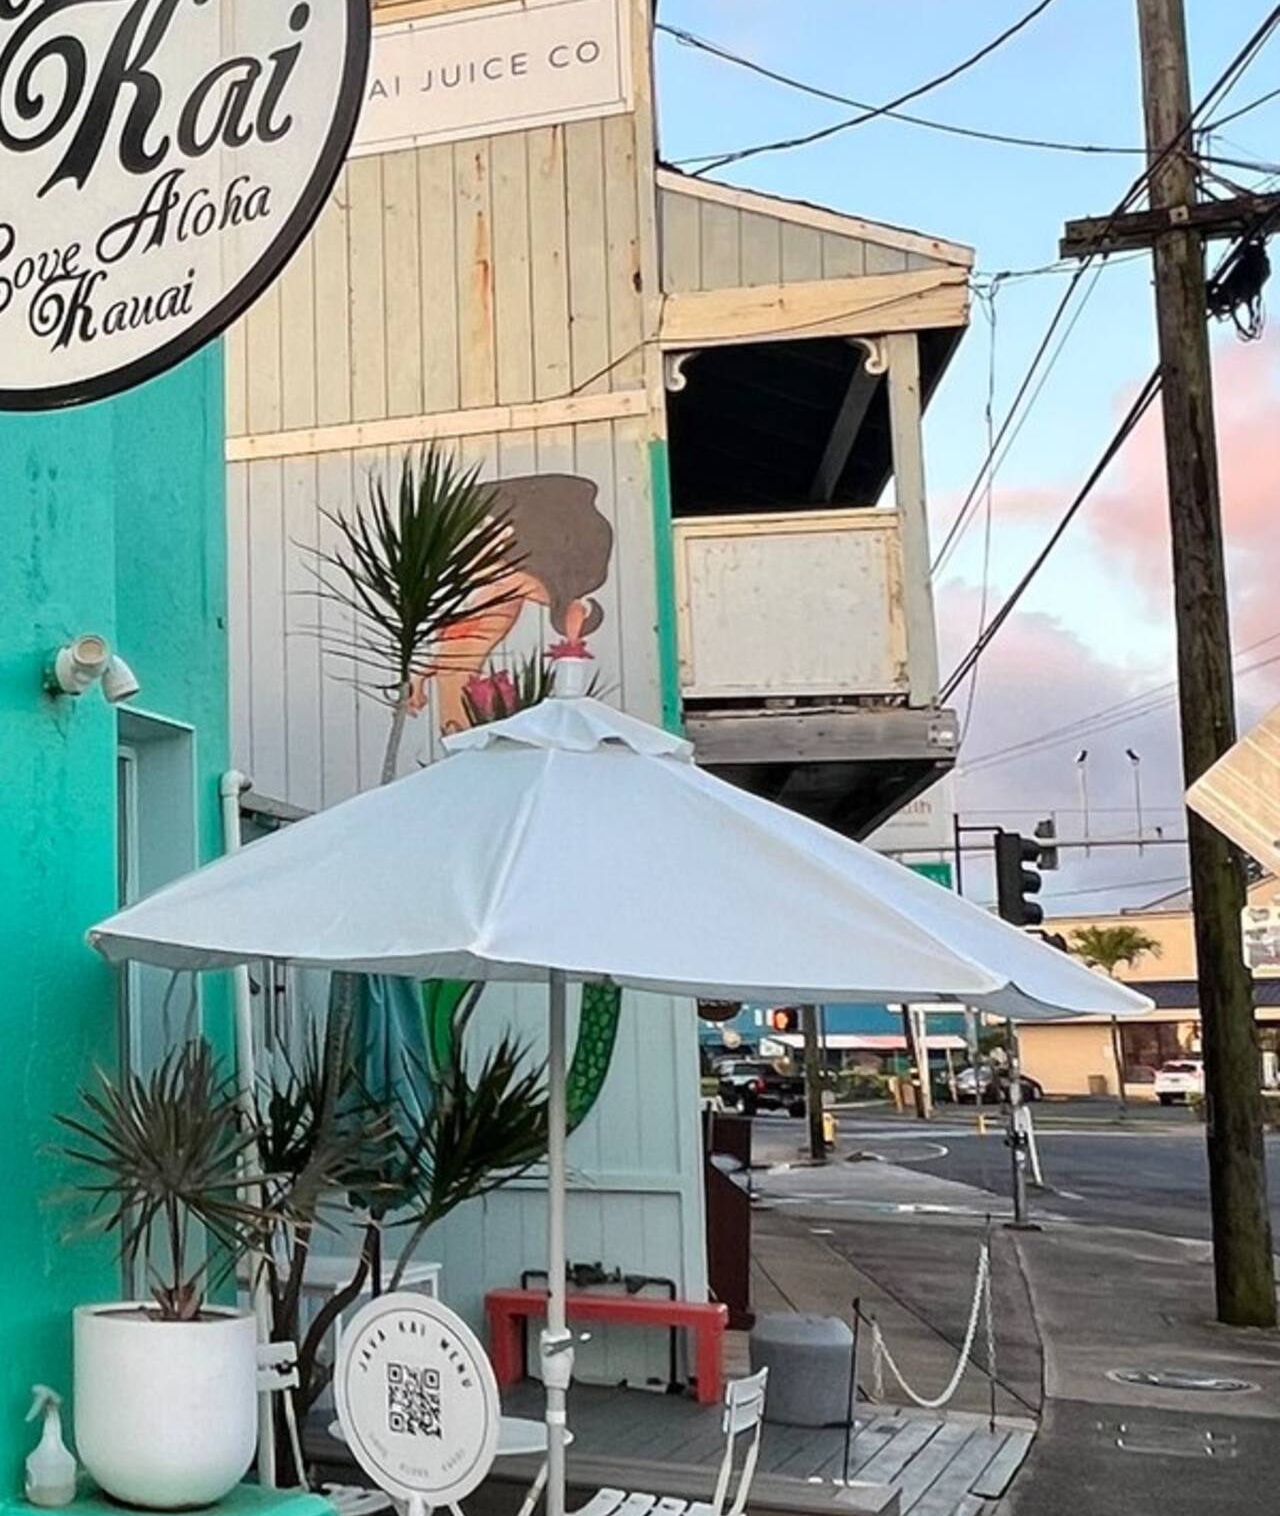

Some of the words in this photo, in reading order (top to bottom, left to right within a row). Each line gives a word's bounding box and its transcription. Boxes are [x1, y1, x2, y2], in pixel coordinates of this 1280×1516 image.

[421, 53, 528, 92] JUICE
[548, 40, 600, 69] CO
[96, 168, 271, 263] Aloha
[30, 269, 195, 352] Kauai
[359, 1330, 386, 1372] JAVA
[398, 1321, 425, 1336] KAI
[440, 1338, 472, 1387] MENU
